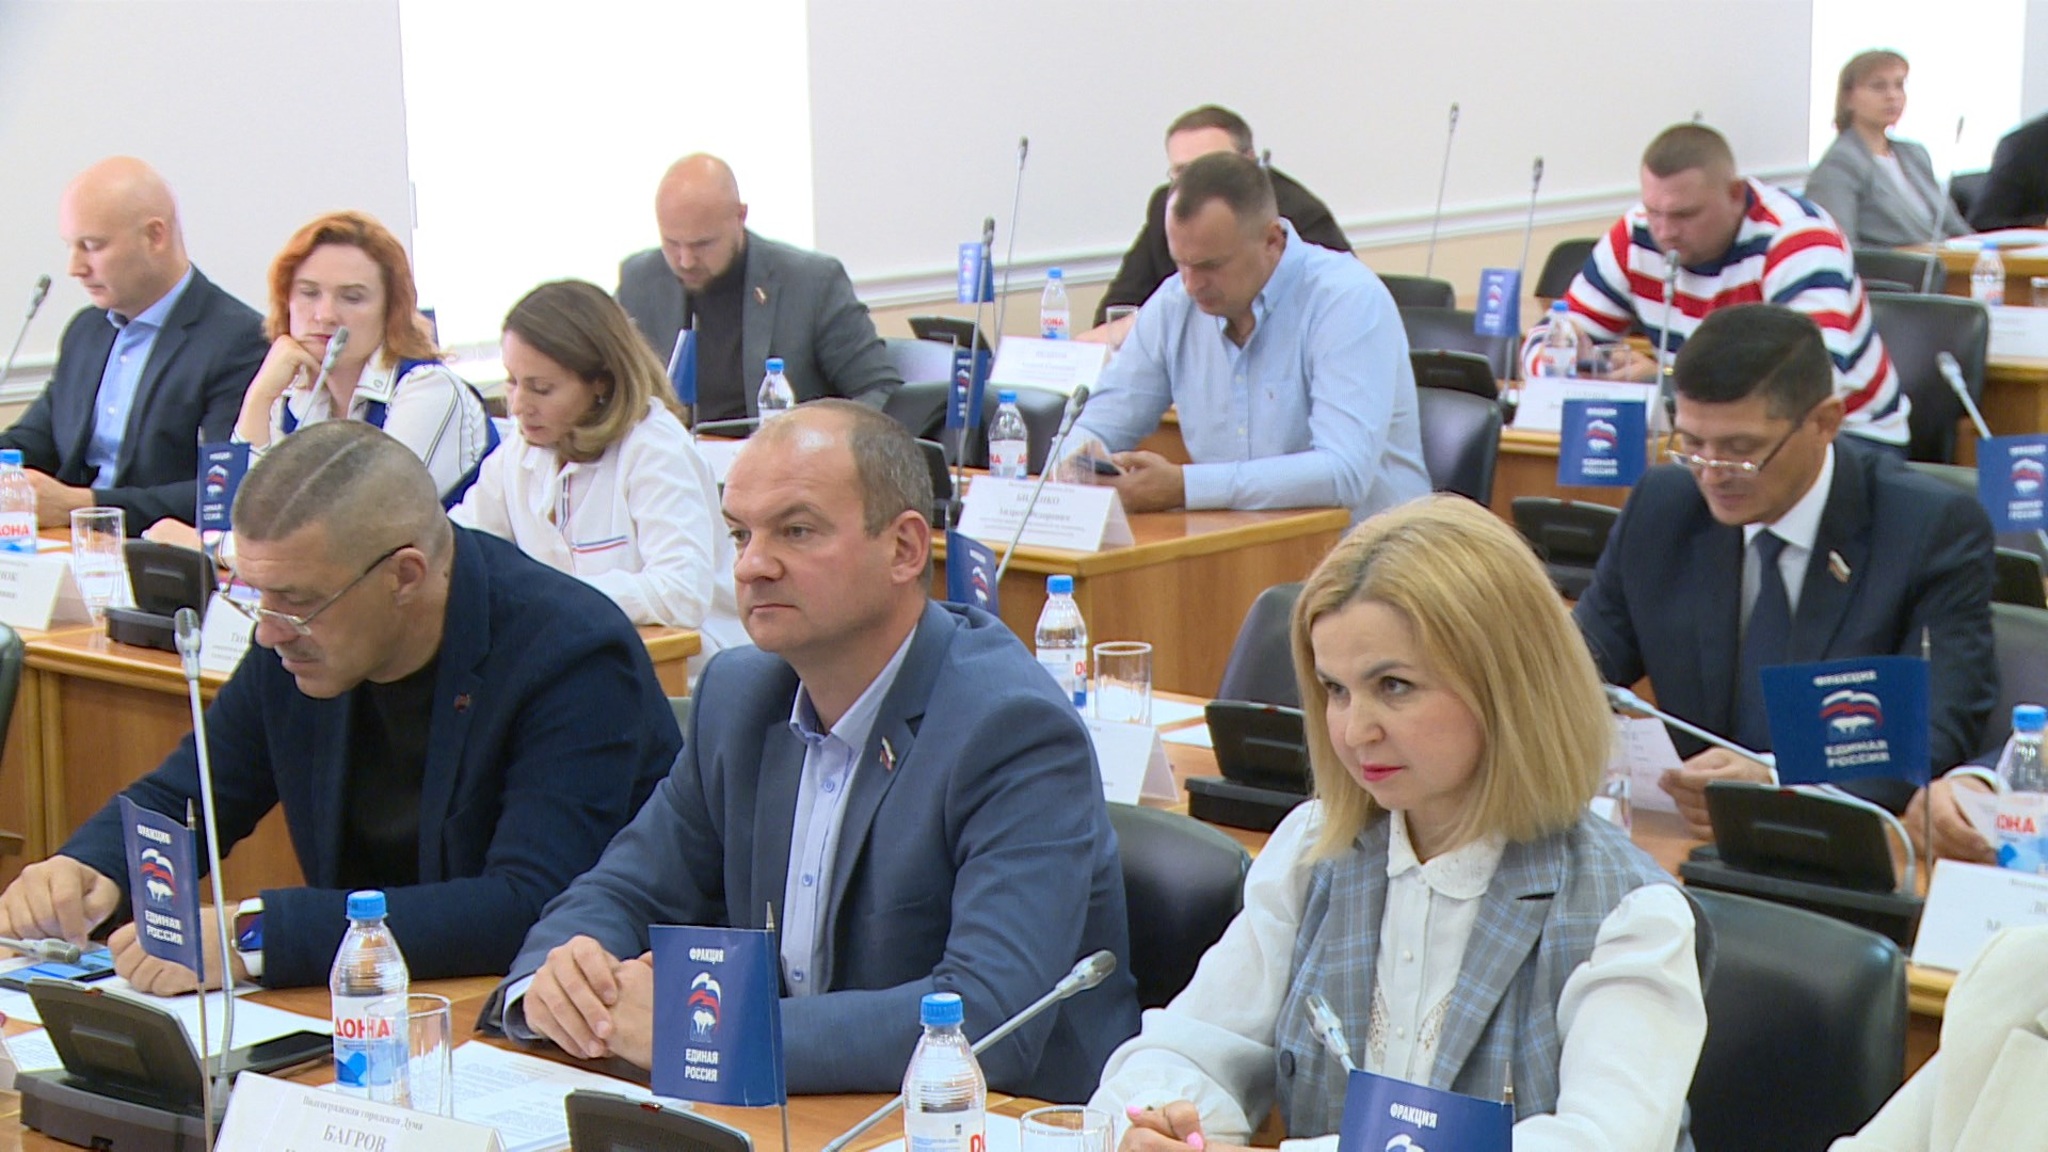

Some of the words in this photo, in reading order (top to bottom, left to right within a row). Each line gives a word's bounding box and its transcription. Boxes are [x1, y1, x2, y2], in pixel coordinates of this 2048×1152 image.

[1813, 669, 1877, 687] ФРАКЦИЯ
[1824, 739, 1888, 756] ЕДИНАЯ
[1826, 752, 1890, 768] РОССИЯ
[137, 824, 172, 844] ФРАКЦИЯ
[1996, 814, 2037, 834] ОНА
[145, 910, 182, 931] ЕДИНАЯ
[146, 925, 184, 945] РОССИЯ
[689, 947, 724, 964] ФРАКЦИЯ
[685, 1048, 719, 1064] ЕДИНАЯ
[684, 1065, 718, 1082] РОССИЯ
[302, 1095, 360, 1117] Волгоградская
[360, 1108, 400, 1126] городская
[401, 1117, 424, 1132] Дума
[1389, 1102, 1438, 1129] ФРАКЦИЯ
[322, 1123, 388, 1152] БАГРОВ
